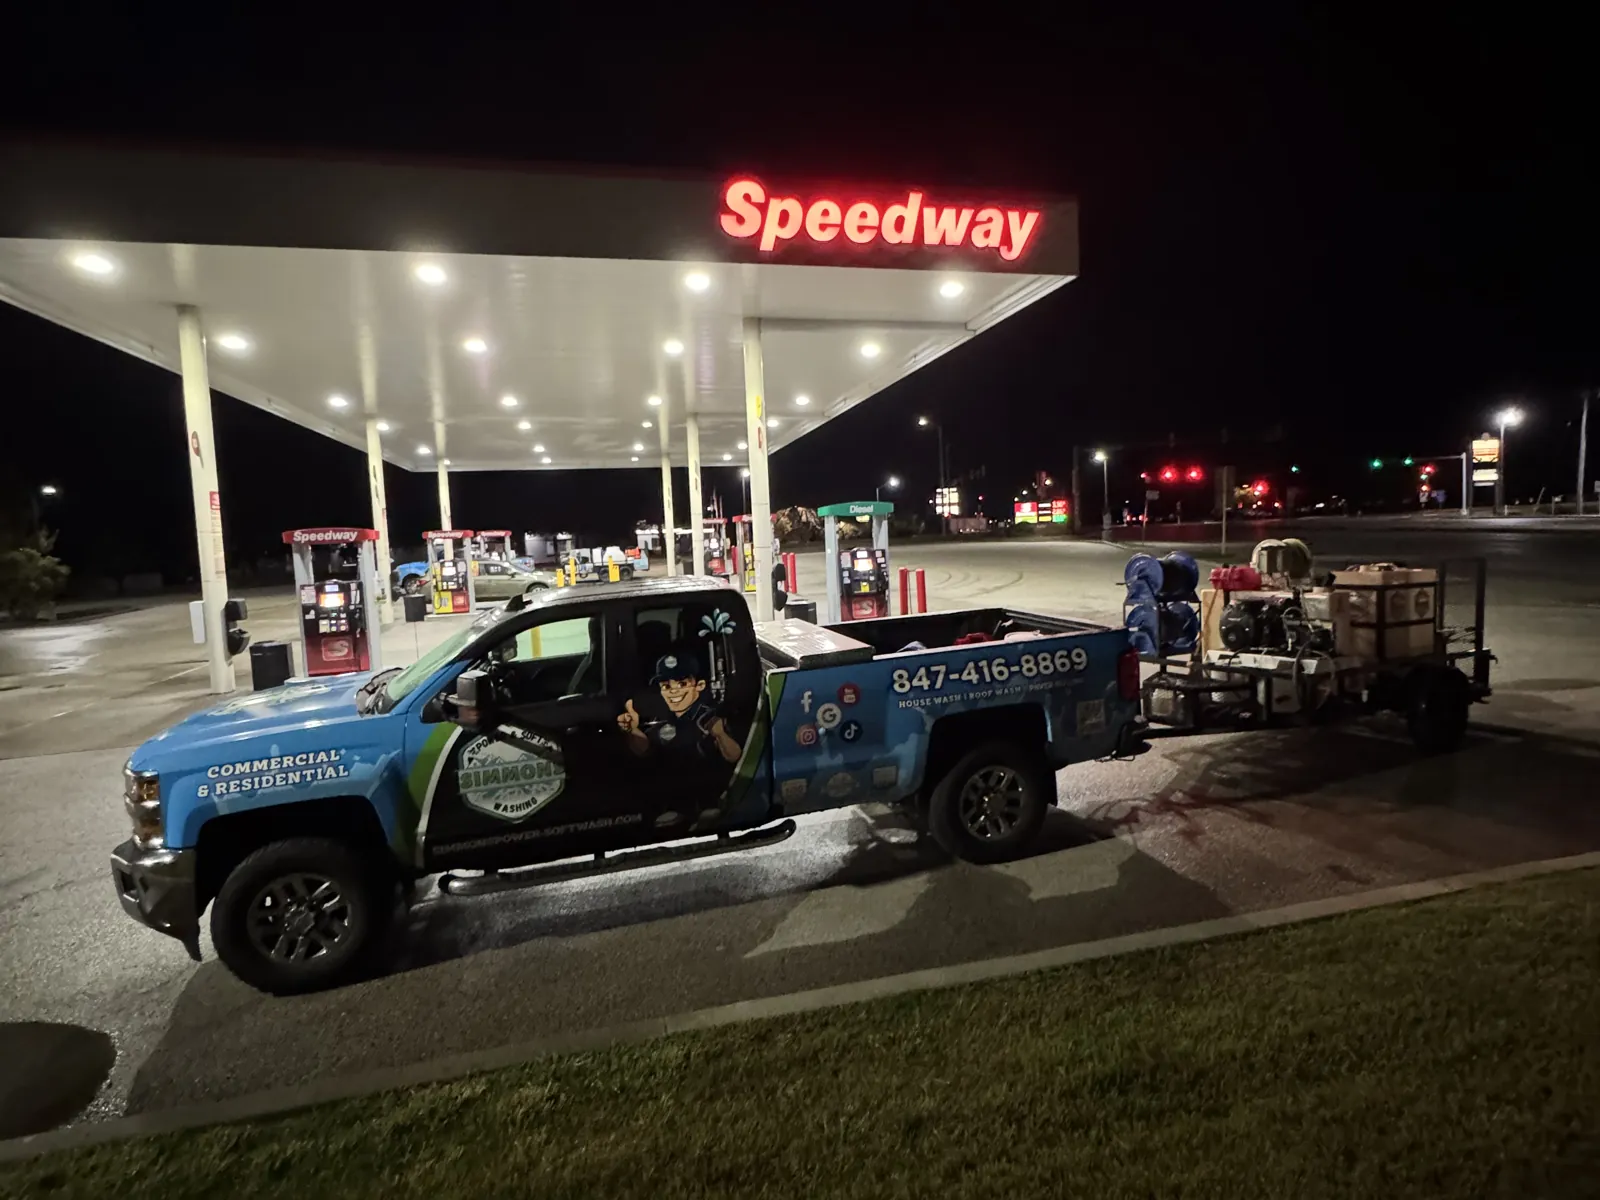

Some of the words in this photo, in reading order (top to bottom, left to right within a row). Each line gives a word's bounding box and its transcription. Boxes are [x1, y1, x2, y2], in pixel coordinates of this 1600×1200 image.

[720, 180, 1040, 261] Speedway
[849, 504, 874, 514] Diesel
[293, 530, 358, 544] Speedway
[893, 648, 1088, 693] 847-416-8869
[899, 698, 932, 709] HOUSE
[934, 694, 962, 704] WASH
[968, 689, 993, 700] ROOF
[995, 686, 1021, 696] WASH
[207, 750, 341, 779] COMMERCIAL
[196, 784, 210, 798] &
[215, 765, 349, 795] RESIDENTIAL
[493, 796, 538, 813] WASHING
